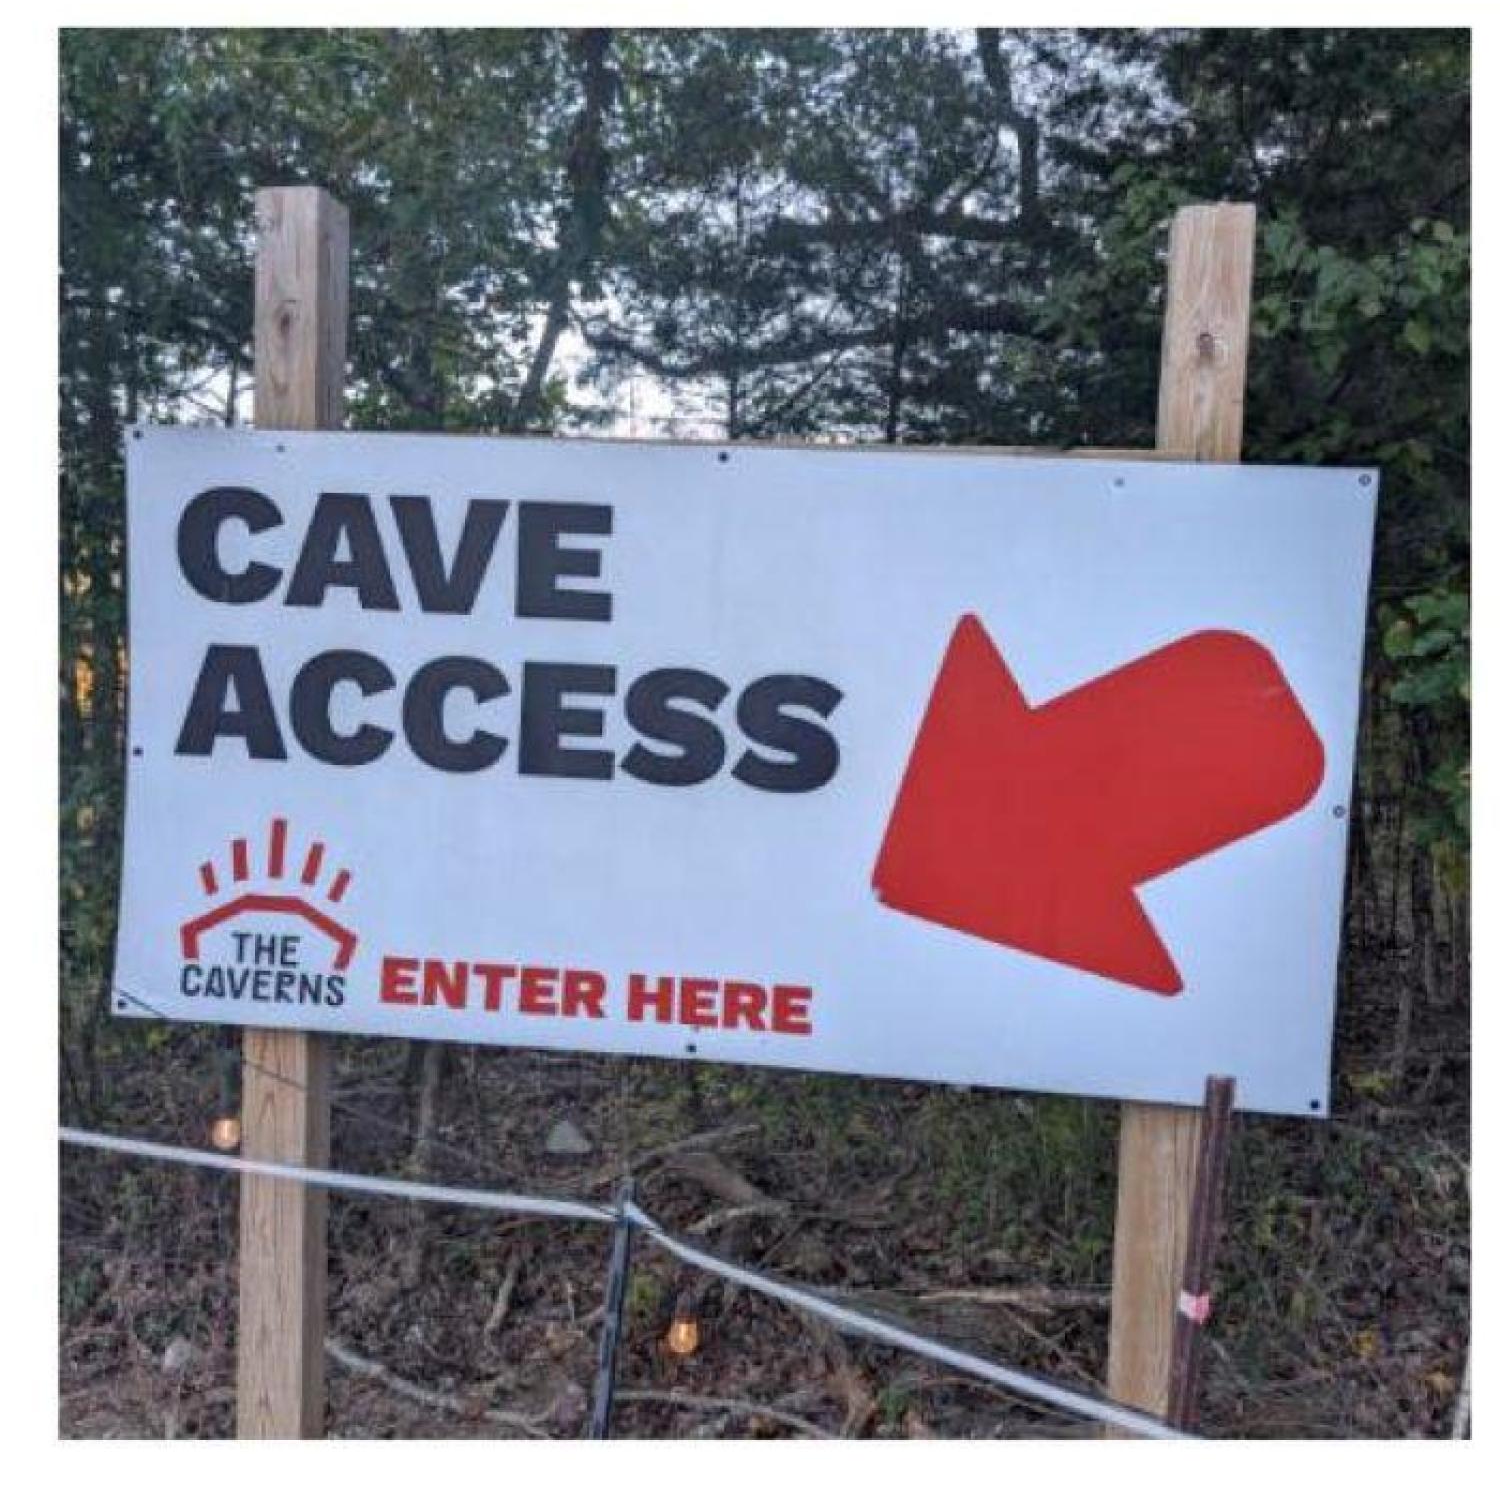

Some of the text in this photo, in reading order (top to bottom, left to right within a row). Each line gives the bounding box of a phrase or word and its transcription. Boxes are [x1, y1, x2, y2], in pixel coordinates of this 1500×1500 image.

[176, 486, 614, 622] CAVE
[174, 642, 845, 794] ACCESS
[180, 964, 345, 1006] CAVERNS
[232, 931, 302, 968] THE
[378, 956, 814, 1034] ENTER HERE
